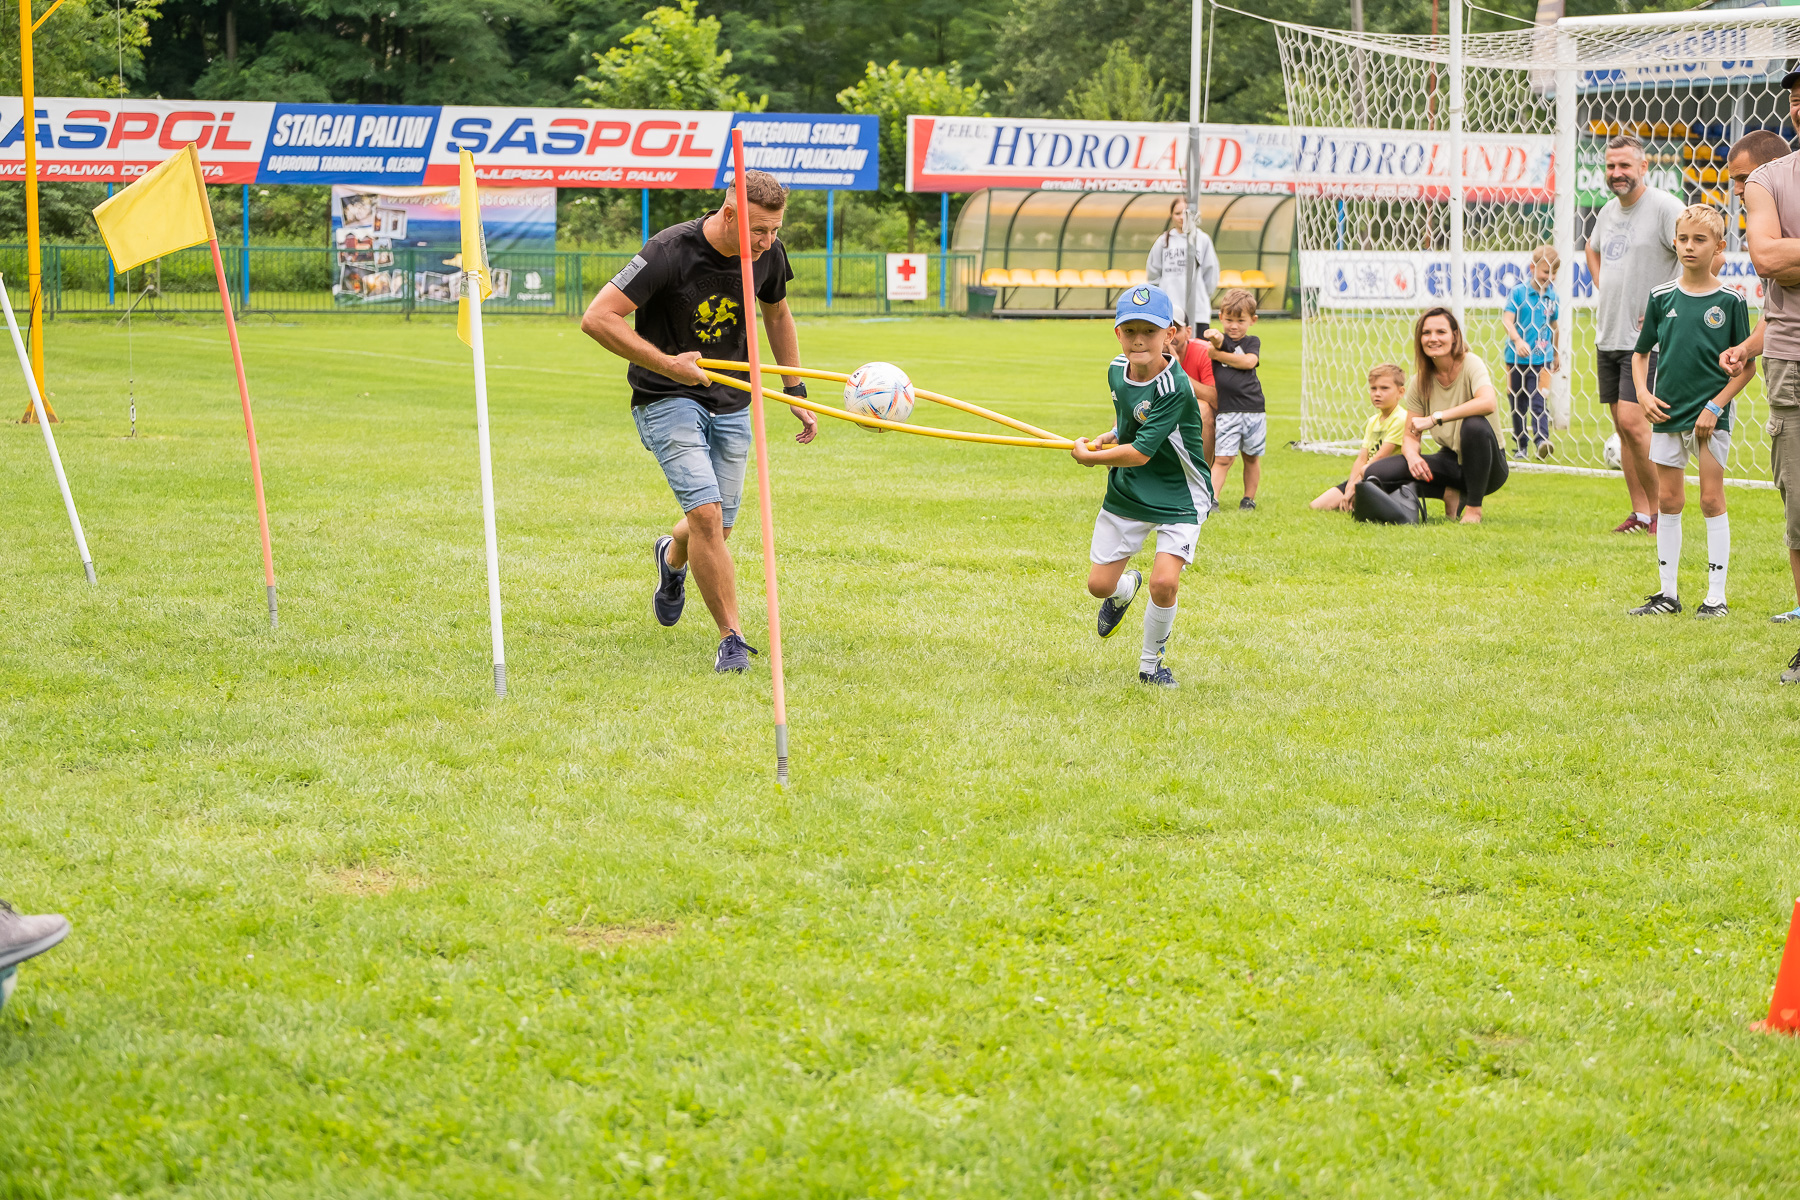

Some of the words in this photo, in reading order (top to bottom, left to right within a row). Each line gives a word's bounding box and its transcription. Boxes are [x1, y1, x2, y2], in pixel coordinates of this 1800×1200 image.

[0, 109, 252, 150] ASPOL
[272, 113, 356, 148] STACJA
[355, 115, 433, 149] PALIW
[446, 117, 713, 158] SASPOL
[810, 123, 860, 145] STACJA
[792, 146, 869, 170] POJAZDÓW
[947, 122, 987, 138] F.H.U.
[986, 126, 1242, 178] HYDROLAD
[46, 164, 115, 176] PALIWA
[120, 164, 148, 176] DO
[267, 155, 320, 174] DĄBROWA
[319, 156, 385, 174] TARNOWSKA,
[385, 156, 425, 173] OLESNO
[459, 168, 554, 181] AJLEPSZA
[557, 167, 624, 183] JAKOŚĆ
[625, 171, 678, 182] PALIW
[1083, 179, 1293, 195] HYDROLAND.URO@WP.PL
[1577, 169, 1681, 198] DĄVIA
[1164, 247, 1201, 261] PEANS
